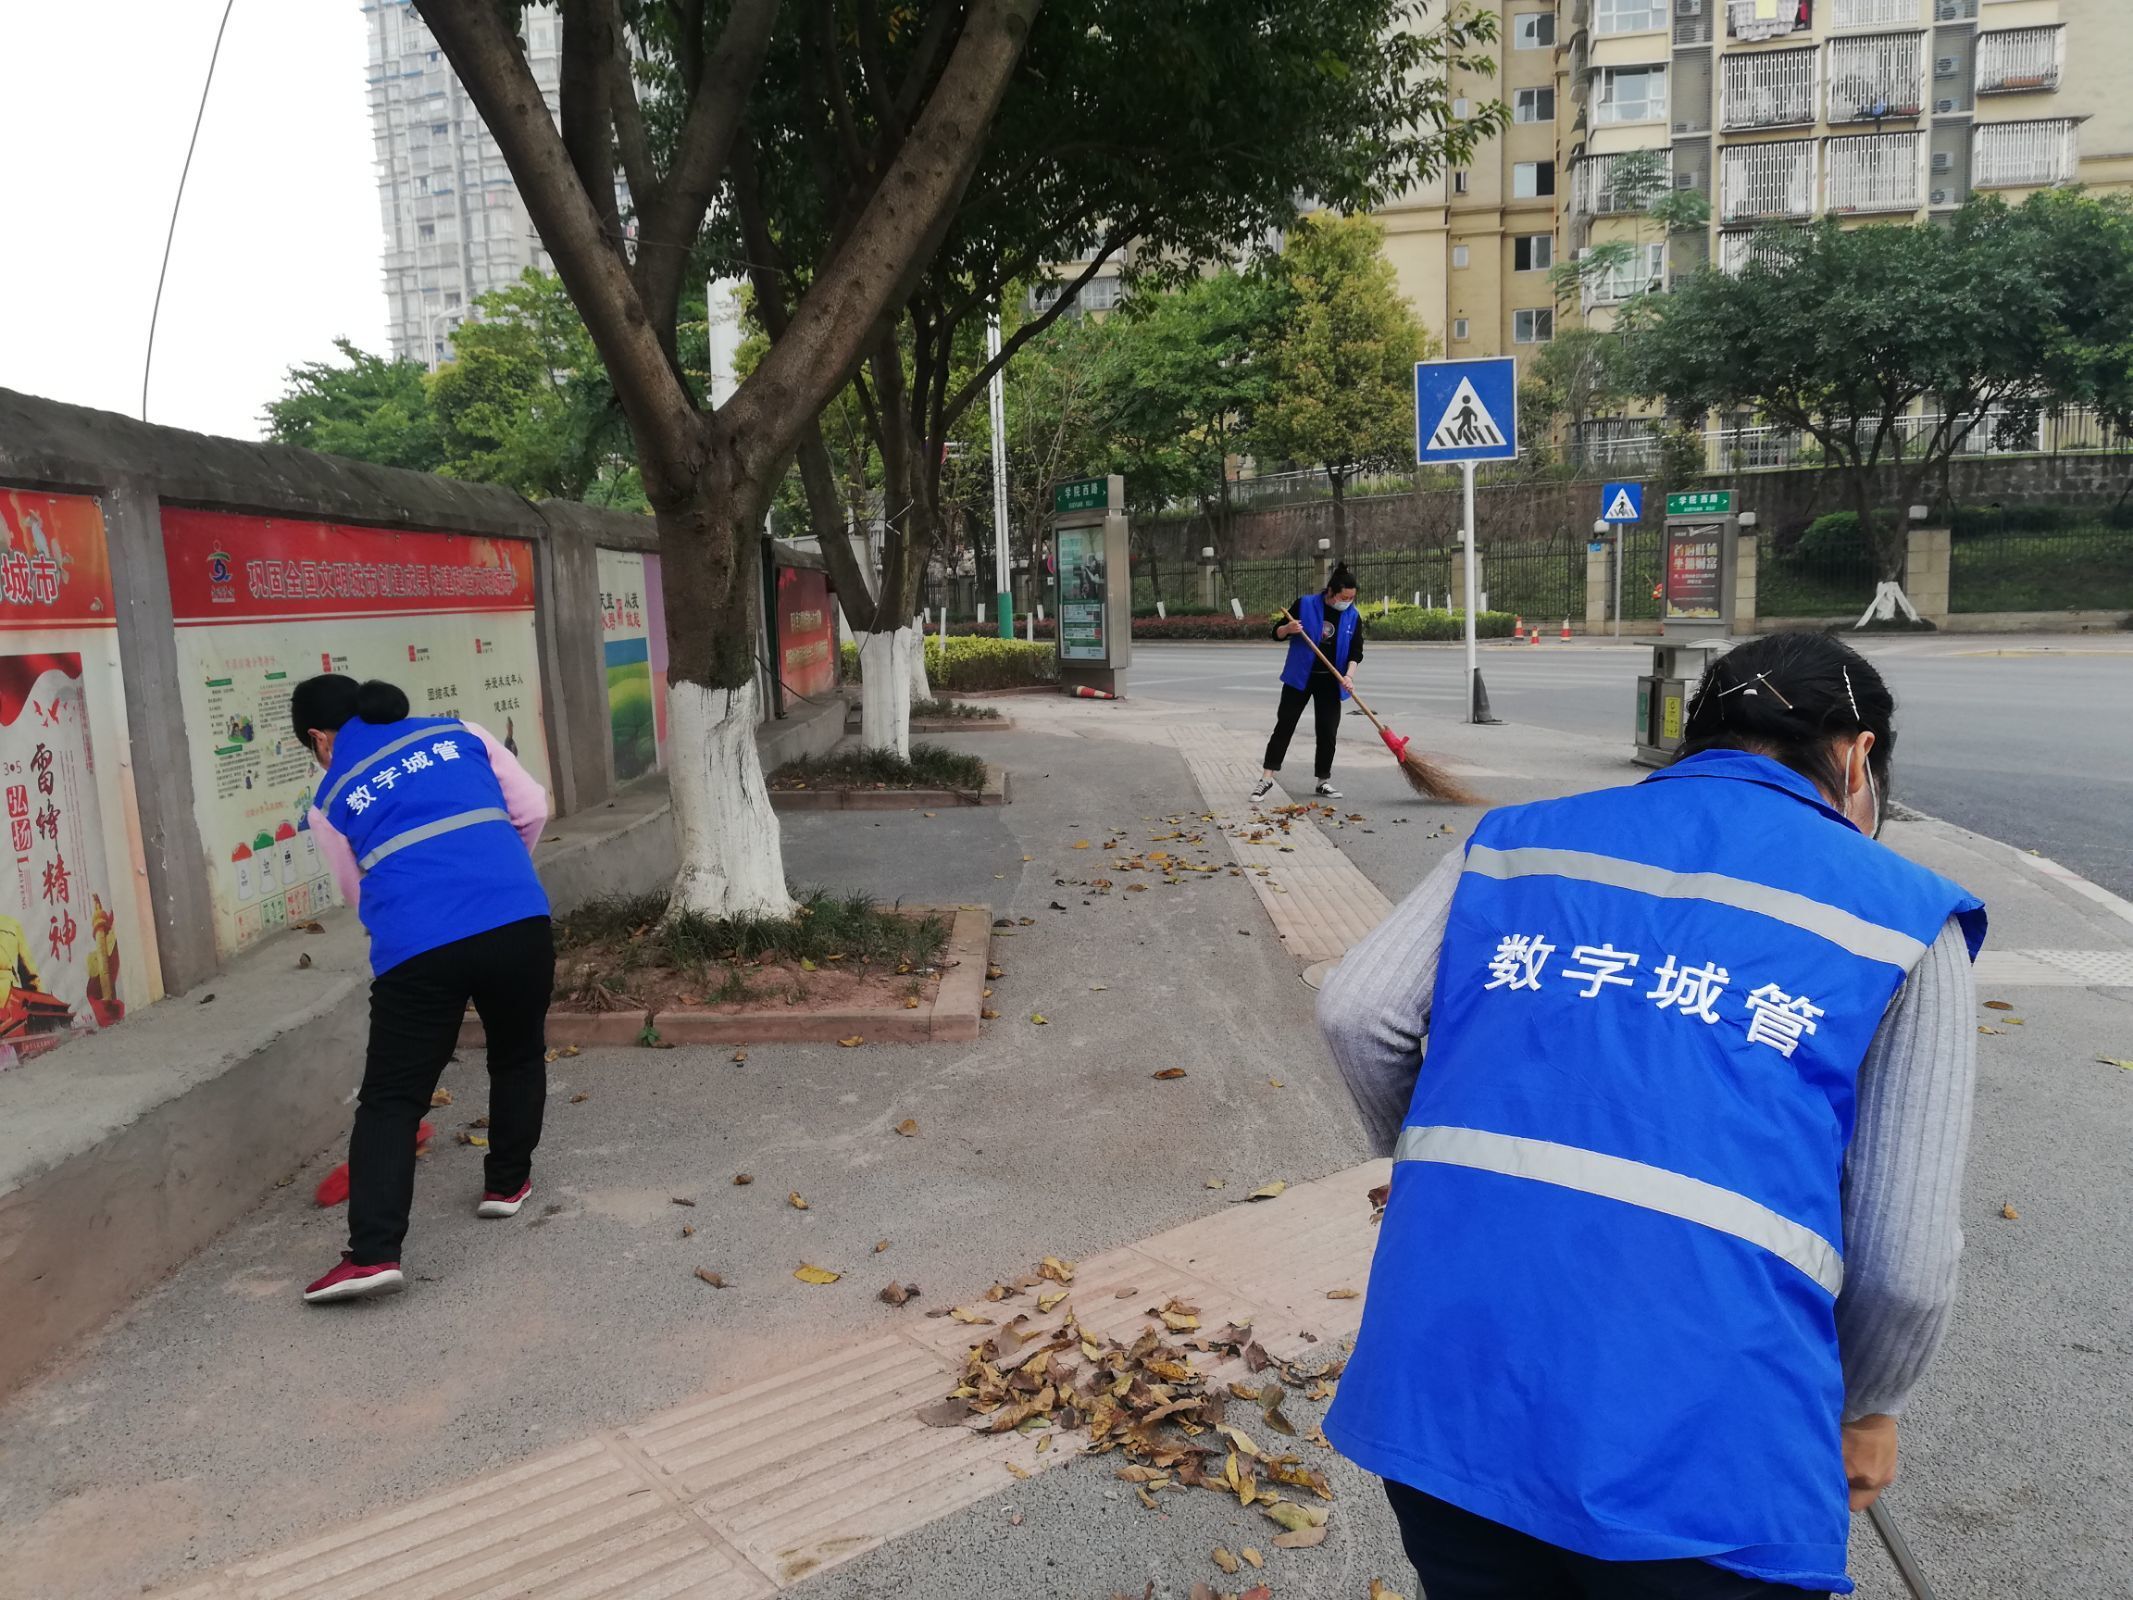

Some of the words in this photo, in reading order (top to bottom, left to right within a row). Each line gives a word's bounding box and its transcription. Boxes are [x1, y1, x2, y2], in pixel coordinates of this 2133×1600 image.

[1064, 483, 1098, 499] 学院西路
[0, 551, 59, 605] 城市
[346, 740, 460, 815] 数字城管
[6, 784, 33, 852] 弘扬
[30, 742, 77, 963] 雷锋精神
[1484, 934, 1825, 1058] 数字城管
